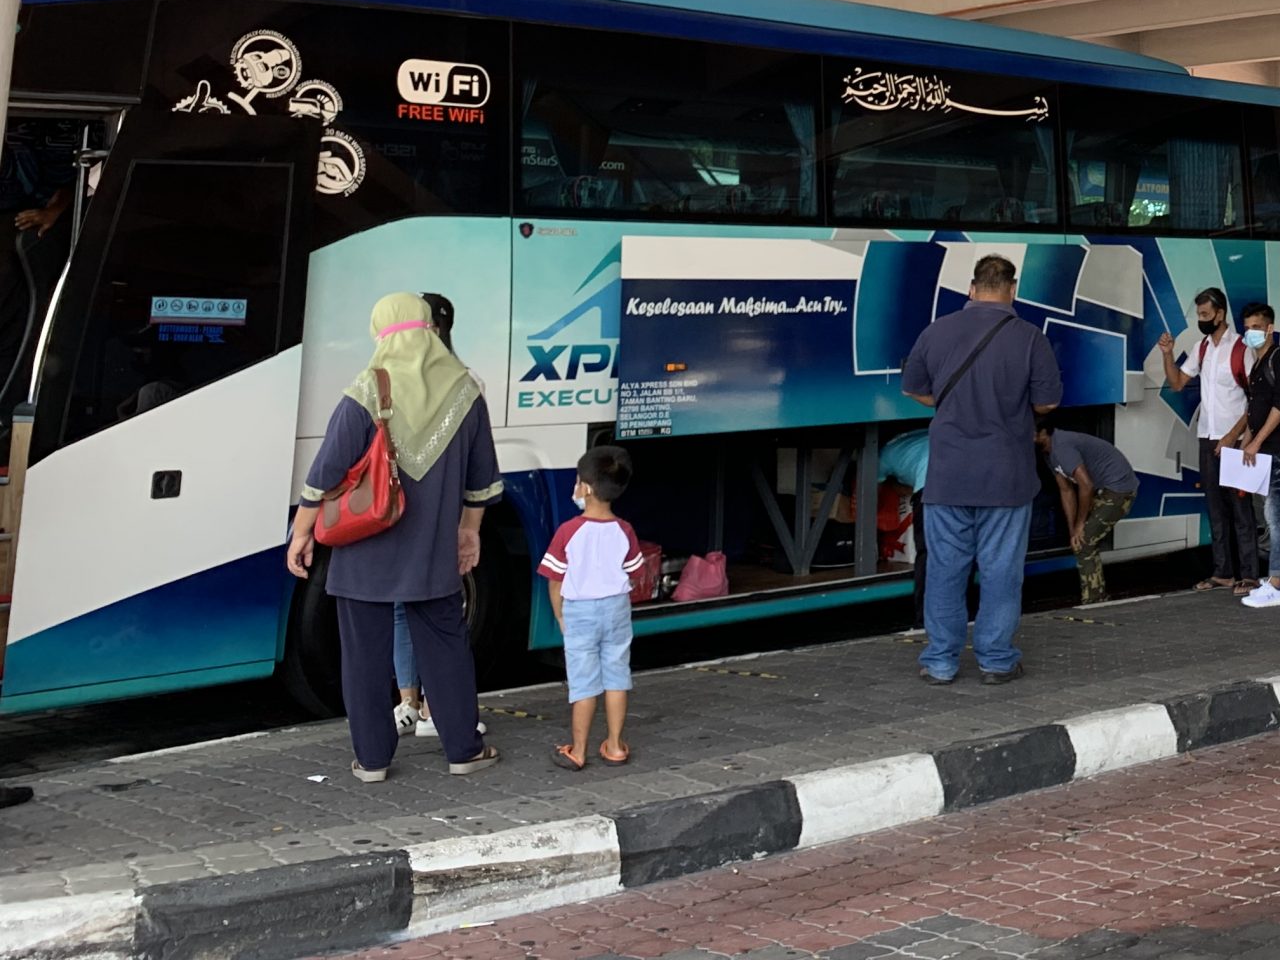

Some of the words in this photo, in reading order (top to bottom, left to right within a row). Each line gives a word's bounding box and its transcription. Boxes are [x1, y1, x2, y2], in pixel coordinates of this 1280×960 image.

[397, 104, 444, 121] FREE
[448, 107, 484, 124] WiFi
[351, 140, 364, 158] WITH
[626, 297, 714, 317] Keselesaan
[621, 382, 639, 390] ALYA
[640, 381, 667, 389] XPRESS
[518, 388, 619, 408] EXECU
[620, 397, 645, 405] TAMAN
[646, 395, 675, 404] BANTING
[620, 412, 657, 420] SELANGOR
[629, 419, 672, 428] PENUMPANG
